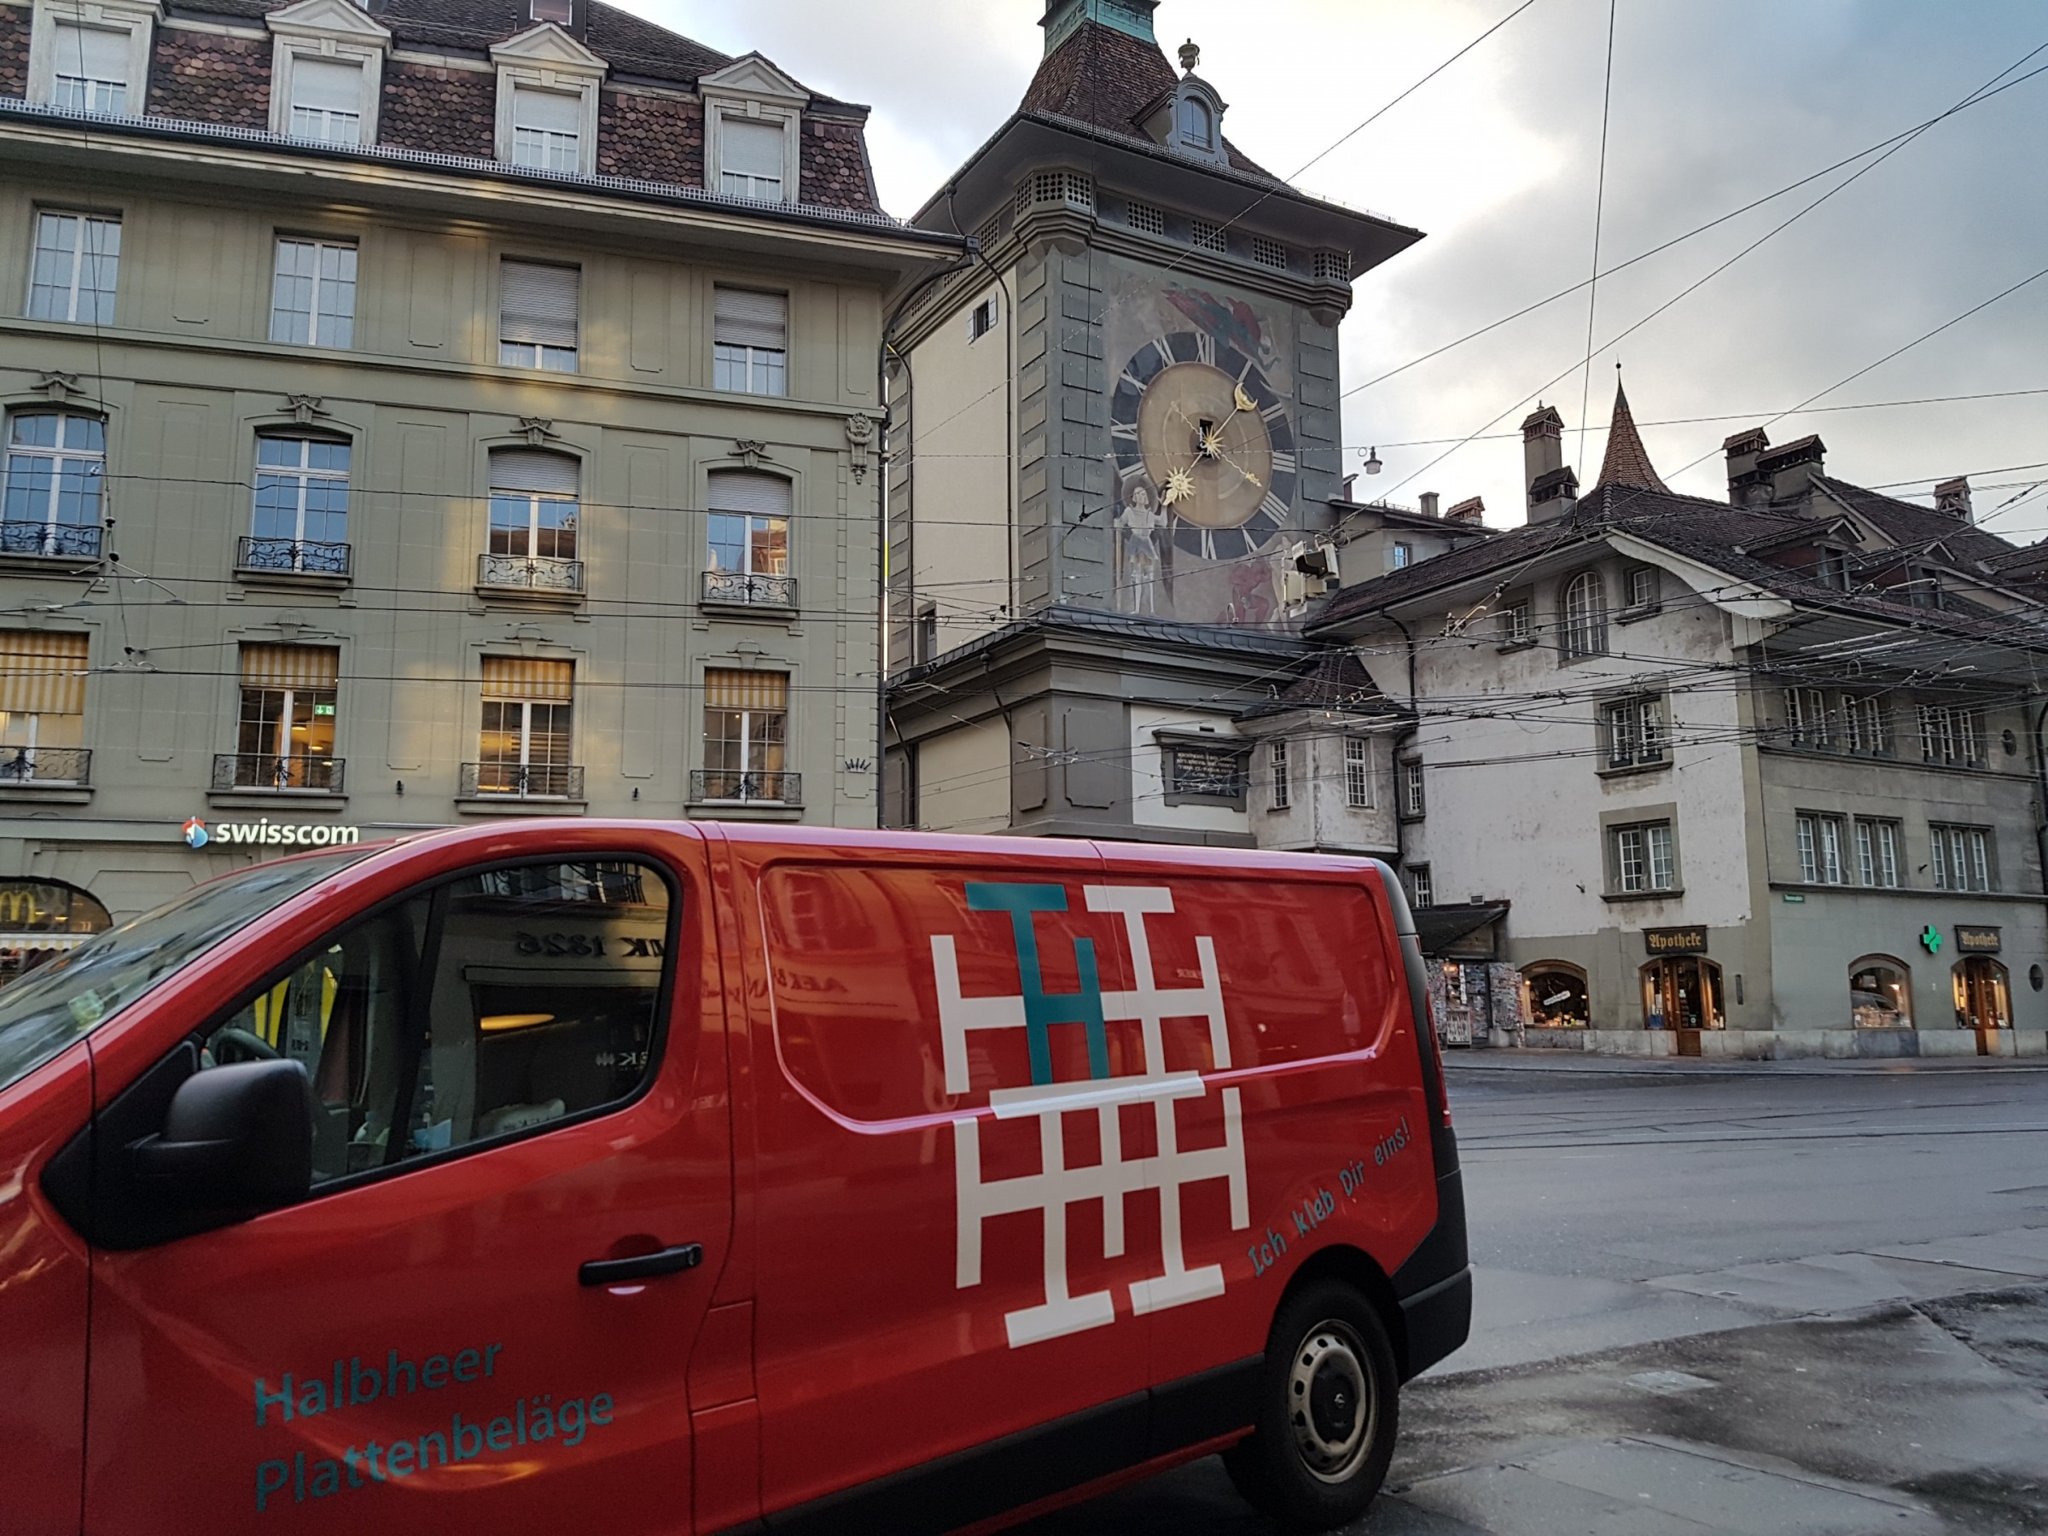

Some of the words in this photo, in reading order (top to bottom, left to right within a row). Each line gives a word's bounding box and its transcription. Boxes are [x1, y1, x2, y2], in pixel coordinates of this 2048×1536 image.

[215, 817, 359, 846] swisscom
[1648, 932, 1702, 950] Apotheke
[1248, 1227, 1288, 1278] Ich
[1291, 1188, 1335, 1238] kleb
[1338, 1160, 1365, 1197] Dir
[1374, 1115, 1412, 1166] eins!
[253, 1343, 504, 1429] Halbheer
[255, 1391, 616, 1513] Plattenbeläge
